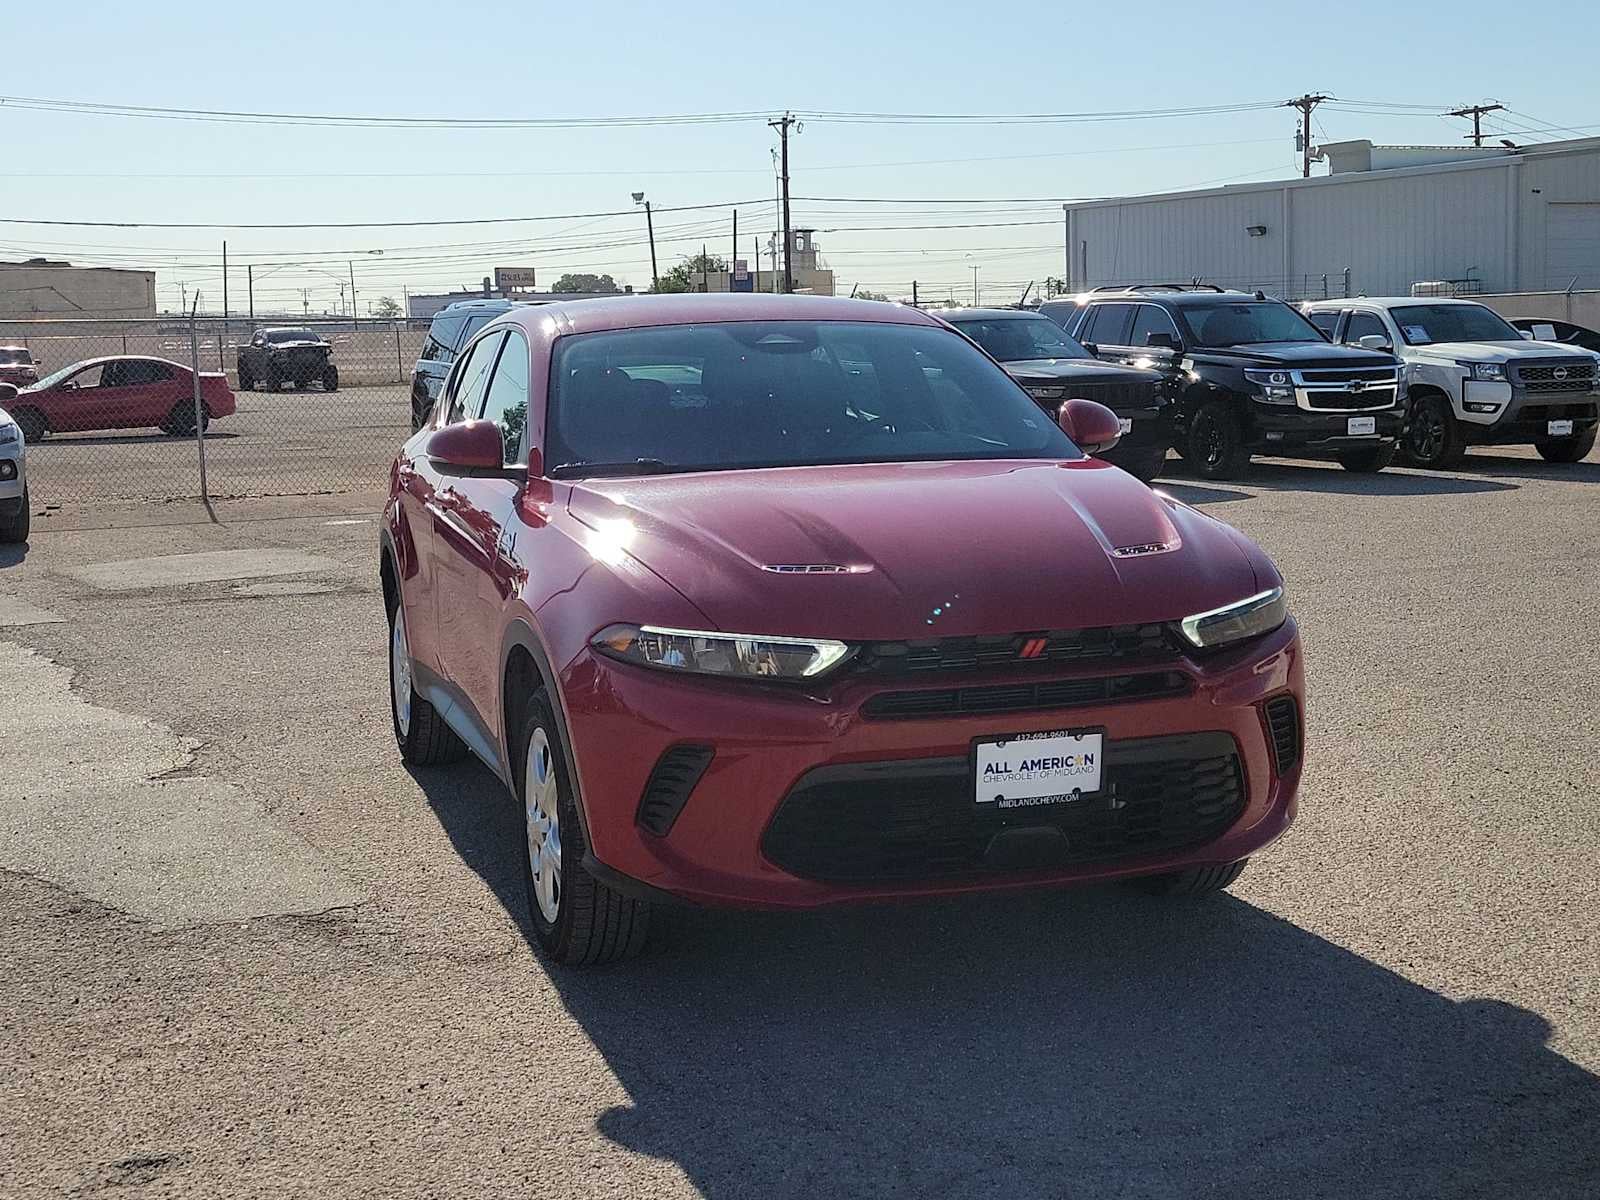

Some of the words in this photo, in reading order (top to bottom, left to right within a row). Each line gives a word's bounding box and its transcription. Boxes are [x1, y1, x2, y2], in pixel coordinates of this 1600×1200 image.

[983, 772, 1037, 783] CHEVROLET
[1040, 770, 1052, 779] OF
[1054, 766, 1095, 777] MIDLAND
[984, 761, 1012, 774] ALL
[999, 793, 1080, 809] MIDLANDCHEVY.COM
